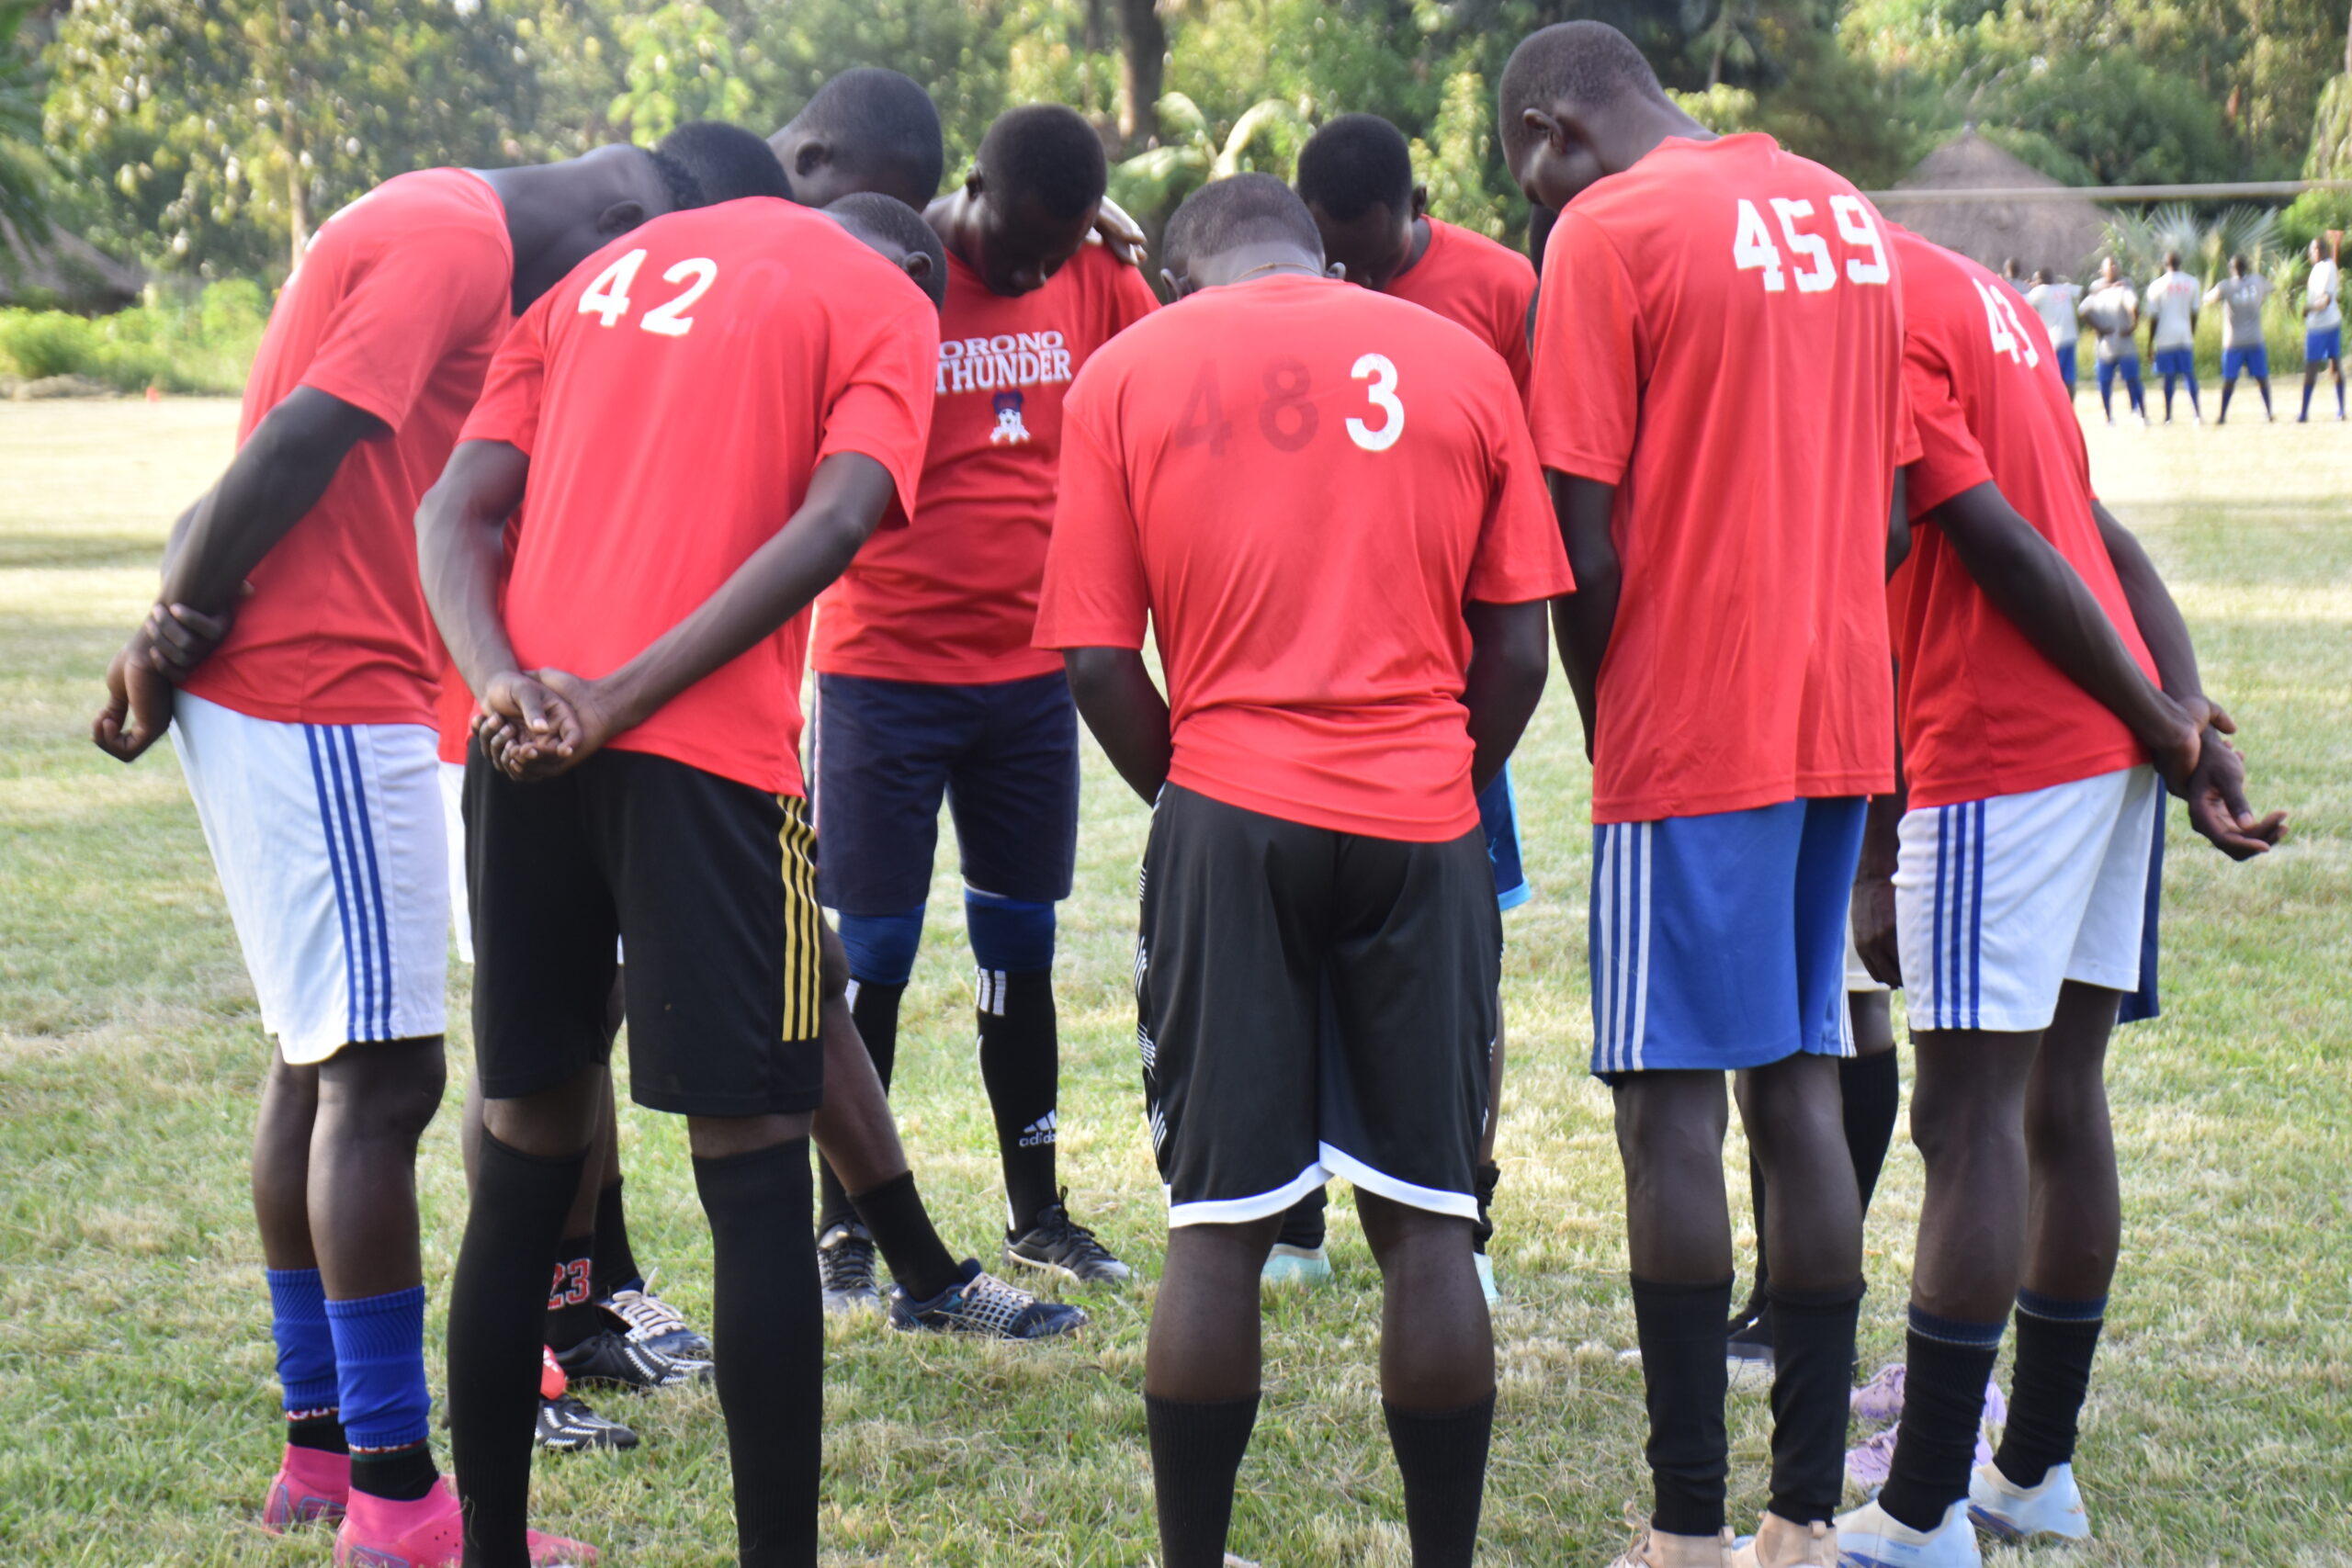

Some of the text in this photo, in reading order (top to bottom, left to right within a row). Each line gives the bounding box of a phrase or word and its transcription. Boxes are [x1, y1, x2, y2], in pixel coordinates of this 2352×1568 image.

[1733, 194, 1890, 293] 459
[940, 331, 1065, 360] ORONO
[1972, 277, 2039, 369] 43
[935, 348, 1073, 395] THUNDER
[1019, 1130, 1057, 1146] adida
[548, 1258, 593, 1310] 23
